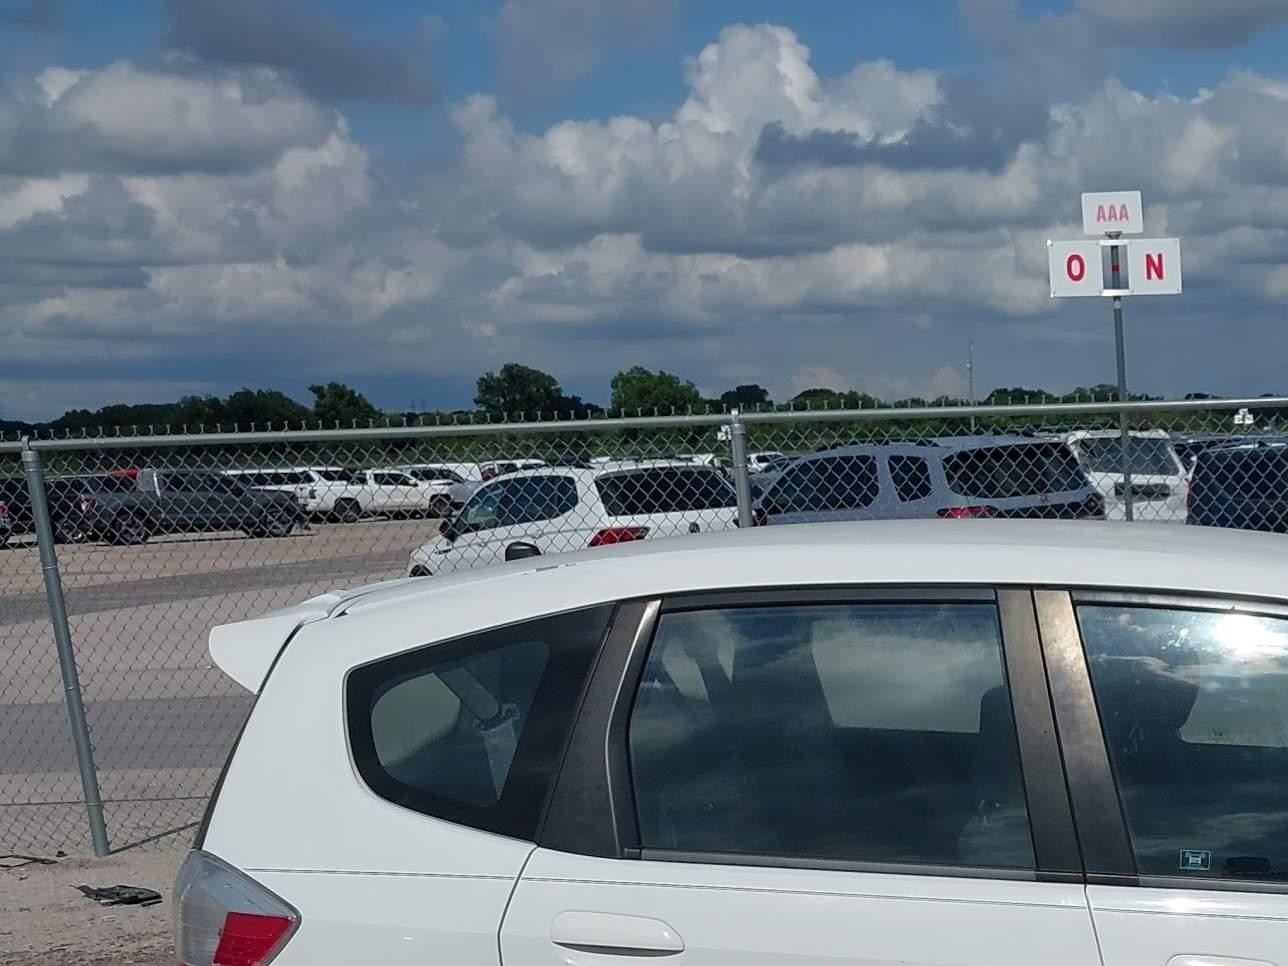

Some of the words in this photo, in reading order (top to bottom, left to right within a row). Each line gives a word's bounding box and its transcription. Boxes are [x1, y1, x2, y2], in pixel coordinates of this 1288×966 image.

[1096, 205, 1129, 222] AAA
[1066, 254, 1086, 282] O
[1145, 253, 1164, 281] N
